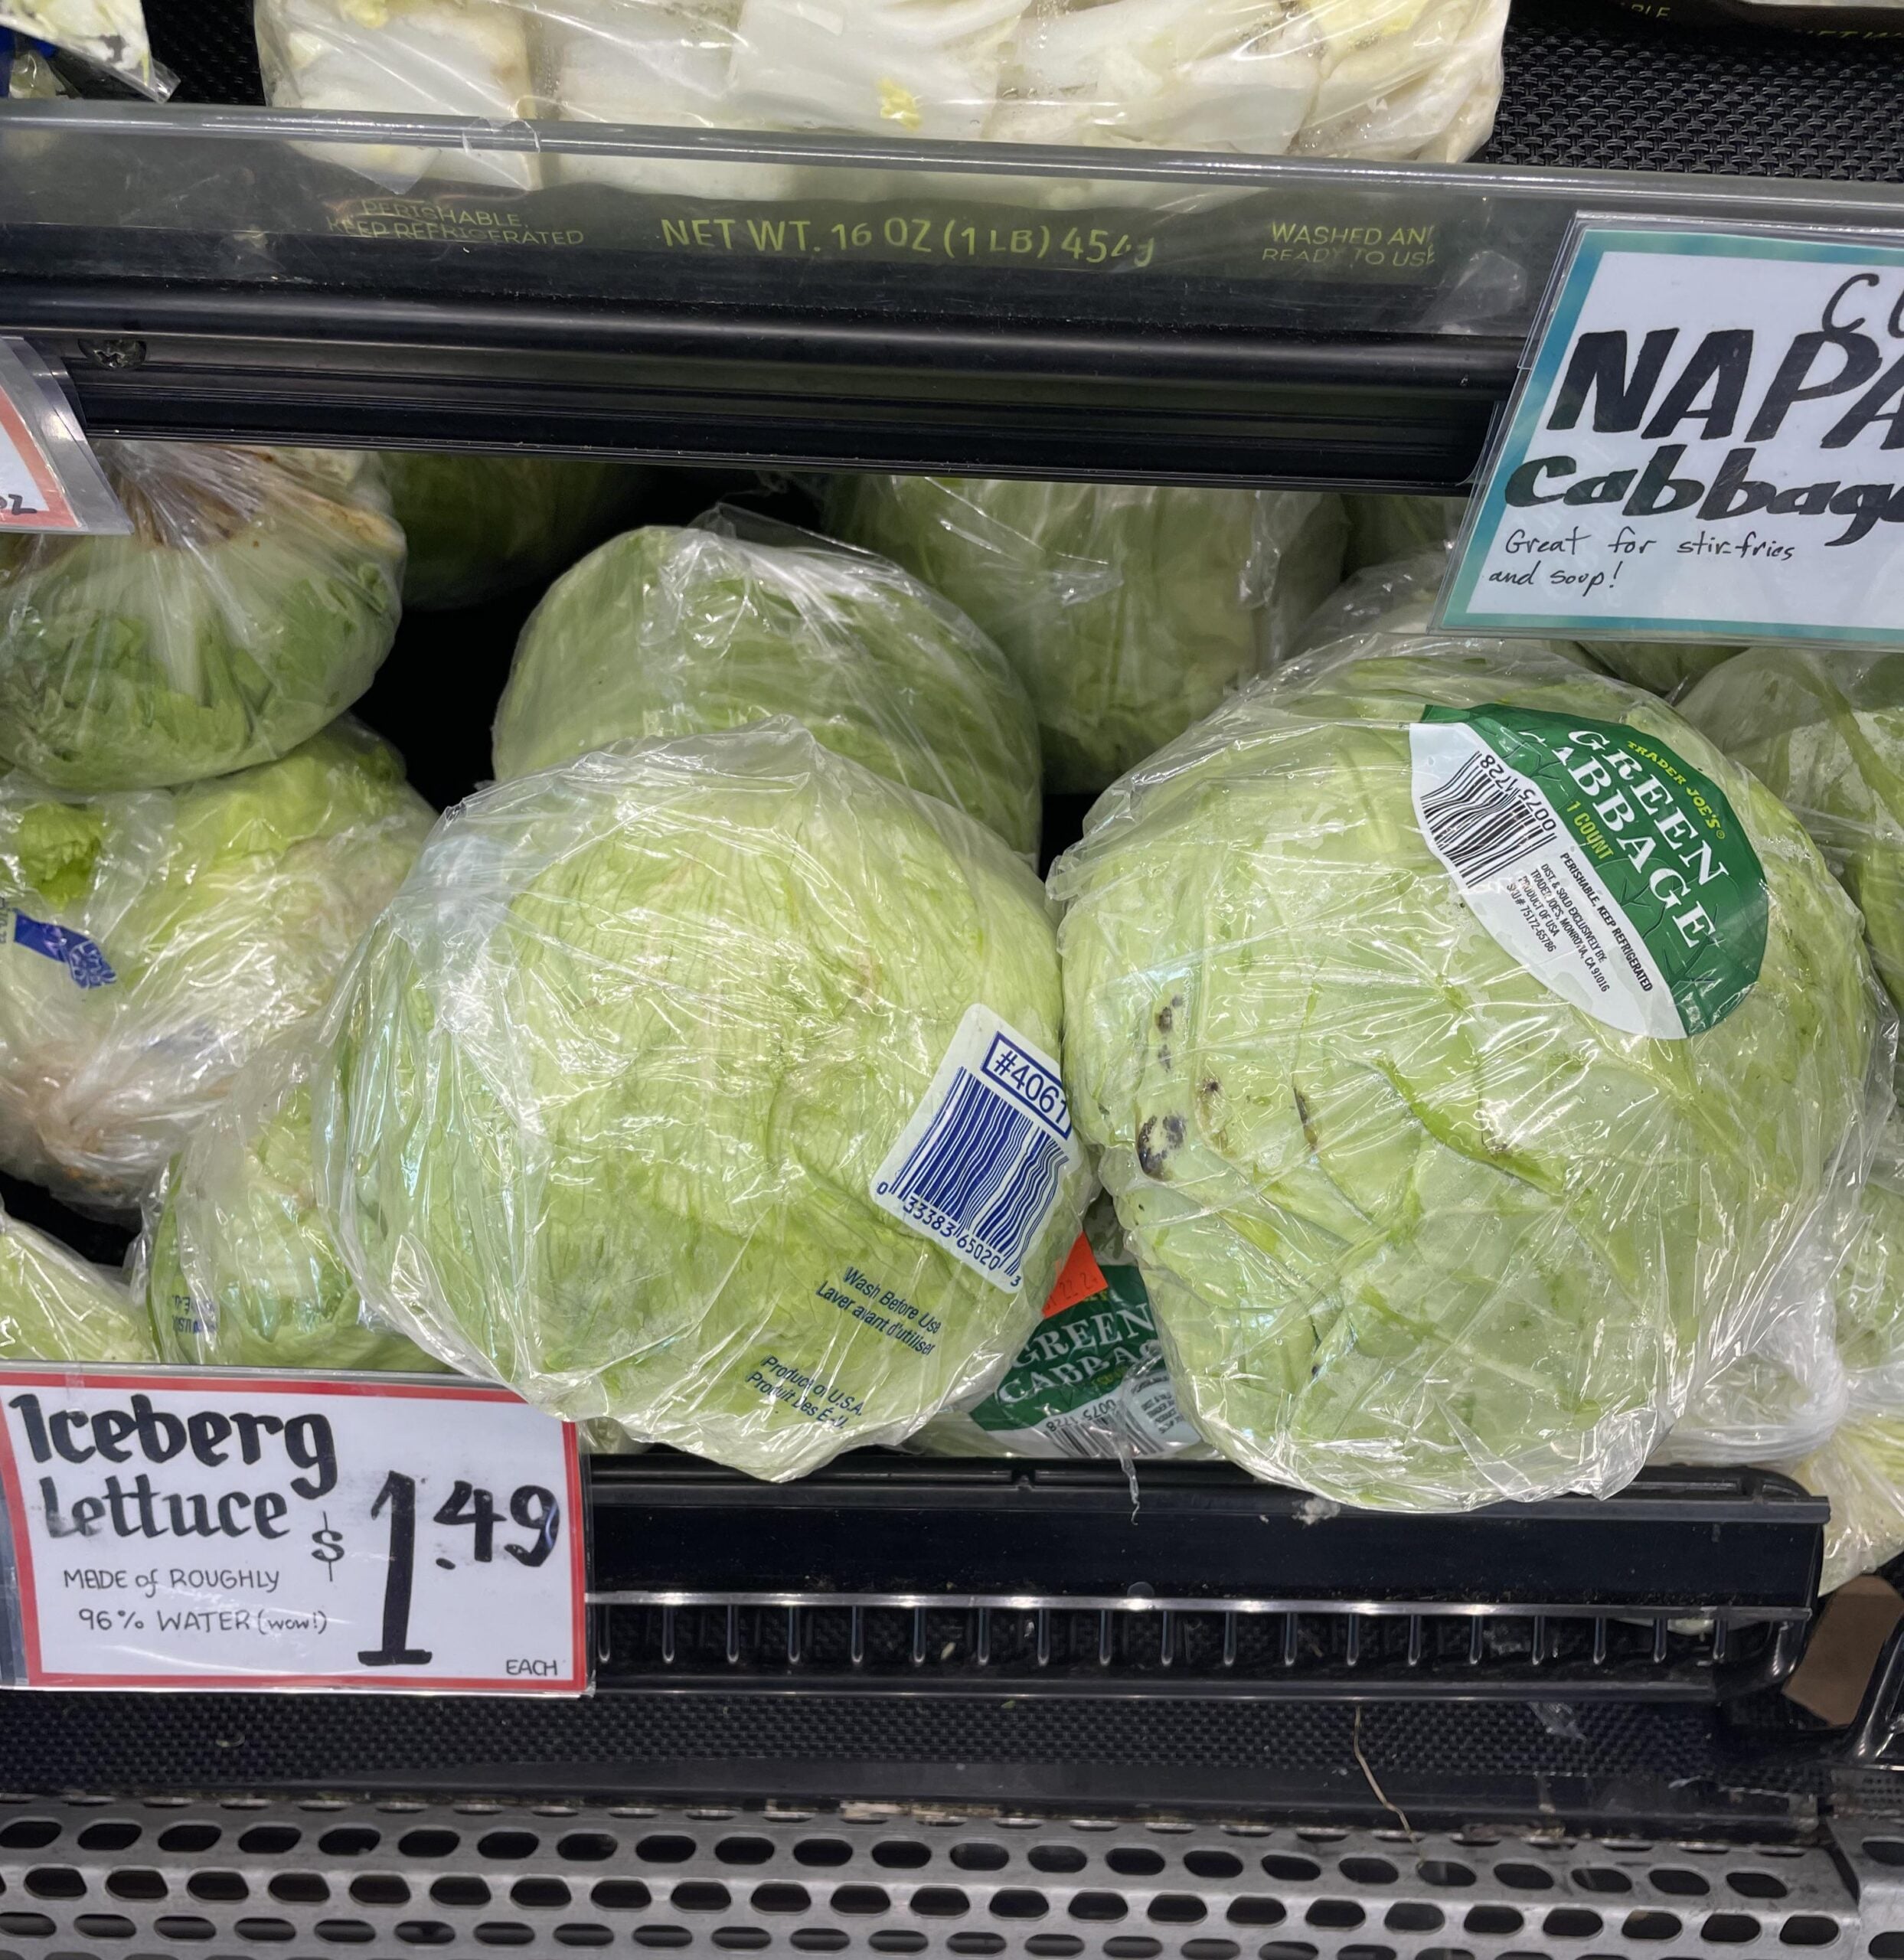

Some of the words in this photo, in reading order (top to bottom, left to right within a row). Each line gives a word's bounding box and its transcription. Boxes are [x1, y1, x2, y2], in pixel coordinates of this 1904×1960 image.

[394, 222, 585, 245] REFRIGERATED
[661, 219, 736, 250] NET
[746, 219, 821, 252] WT.
[831, 223, 873, 251] 16
[883, 217, 932, 253] OZ
[943, 219, 976, 259] (1
[989, 225, 1050, 259] LB)
[1271, 221, 1382, 245] WASHED
[1262, 248, 1345, 263] READY
[1354, 248, 1385, 265] TO
[1546, 328, 1904, 450] NAPA
[1505, 526, 1592, 555] Great
[1608, 526, 1657, 555] for
[1677, 531, 1795, 562] stir-fries
[1488, 560, 1534, 586] and
[1550, 560, 1622, 597] soup!
[1480, 754, 1518, 792] 1728
[1628, 740, 1687, 786] TRADER
[1518, 789, 1556, 831] 0075
[1566, 800, 1582, 812] 1
[1569, 730, 1729, 886] GREEN
[1573, 812, 1615, 860] COUNT
[1518, 875, 1544, 910] PRODUCT
[1539, 910, 1550, 920] OF
[1545, 920, 1559, 937] USA
[1540, 864, 1556, 882] DIST.
[1556, 888, 1573, 907] SOLD
[1568, 906, 1601, 950] EXCLUSIVELY
[1560, 852, 1600, 907] PERISHABLE,
[1597, 906, 1616, 926] KEEP
[1612, 927, 1653, 992] REFRIGERATED
[1520, 905, 1556, 952] 75172-65786
[1585, 957, 1595, 969] CA
[1592, 968, 1610, 992] 91016
[995, 1050, 1067, 1124] #4061
[877, 1181, 889, 1195] 0
[903, 1197, 956, 1237] 33383
[957, 1233, 1001, 1271] 65020
[1009, 1276, 1021, 1287] 3
[816, 1280, 855, 1311] Laver
[852, 1305, 889, 1333] avant
[843, 1266, 881, 1299] Wash
[878, 1290, 919, 1320] Before
[1011, 1303, 1154, 1368] GREEN
[746, 1371, 795, 1403] Produit
[828, 1388, 863, 1416] U.S.A.
[8, 1393, 338, 1500] Iceberg
[64, 1569, 129, 1590] MADE
[136, 1569, 158, 1598] of
[170, 1570, 280, 1593] ROUGHLY
[78, 1609, 144, 1632] 96%
[158, 1610, 250, 1632] WATER
[506, 1659, 559, 1677] EACH
